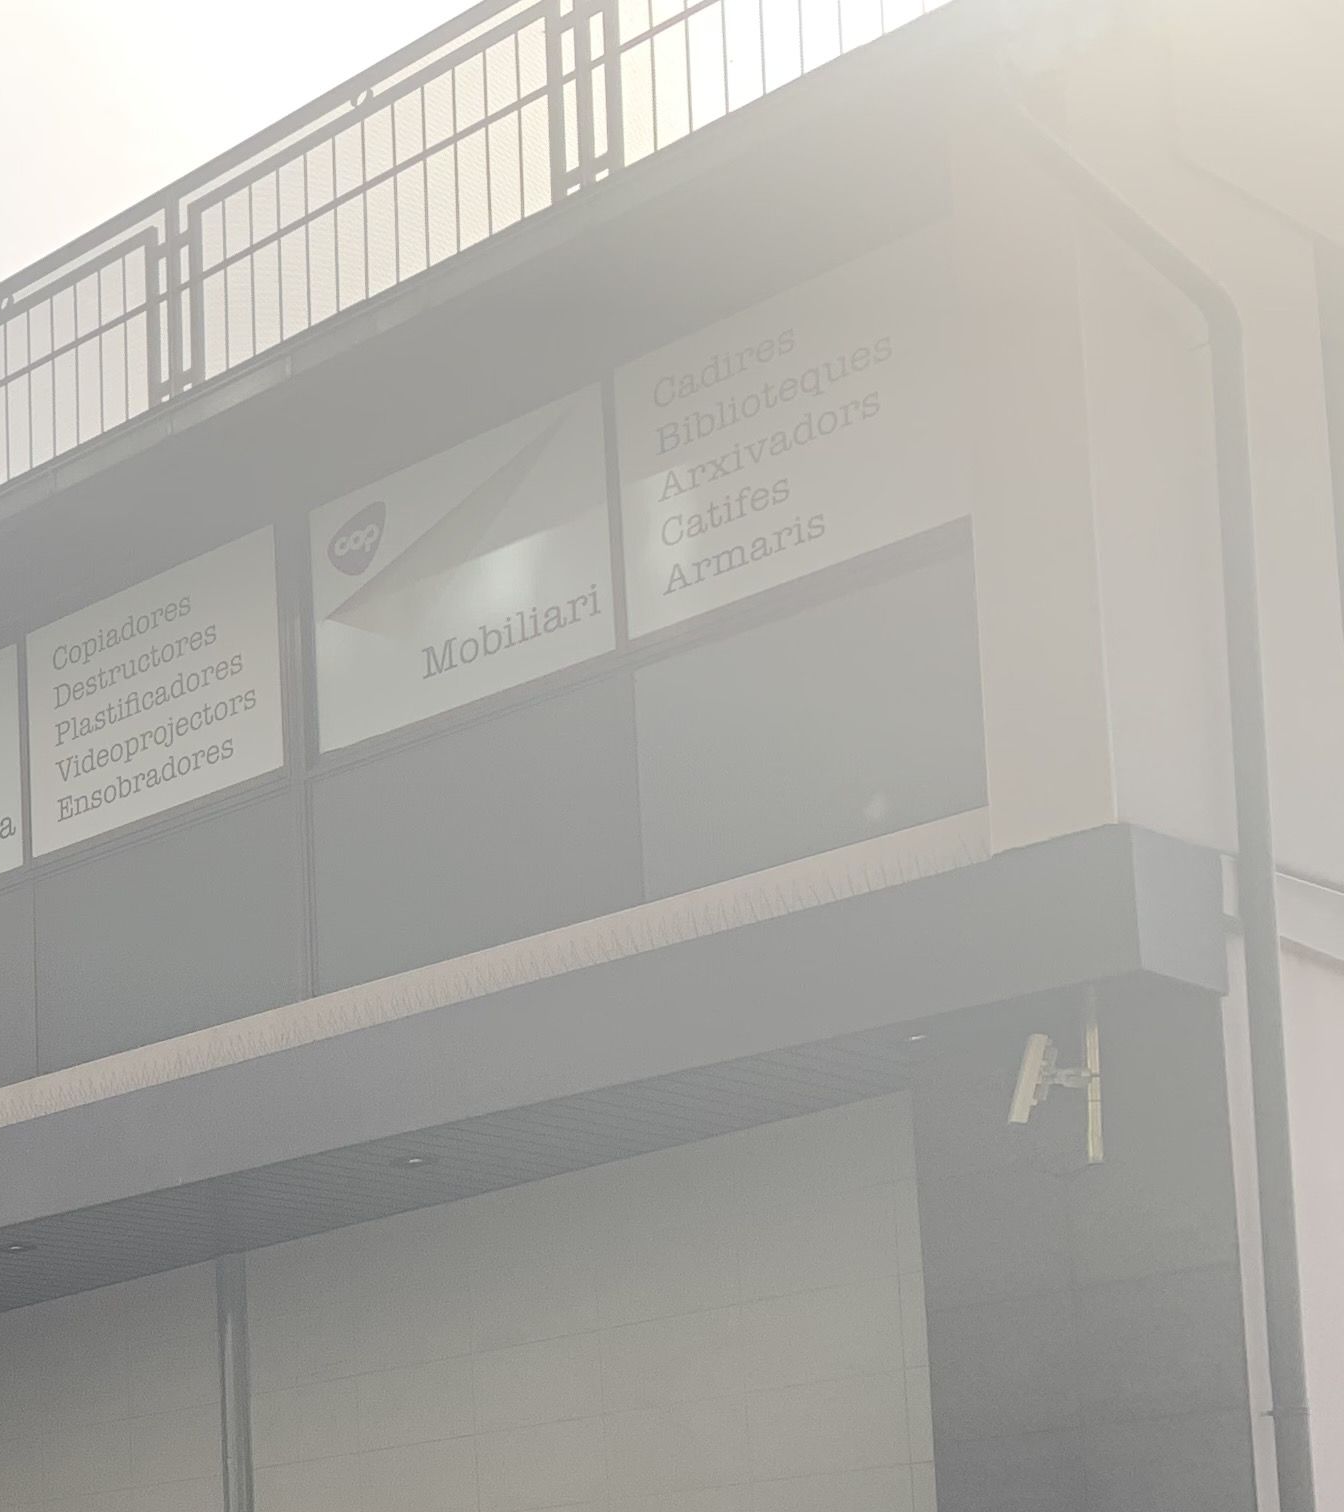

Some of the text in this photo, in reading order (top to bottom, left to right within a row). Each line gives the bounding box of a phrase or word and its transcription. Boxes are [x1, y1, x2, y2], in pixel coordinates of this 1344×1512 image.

[653, 326, 797, 408] Cadires
[654, 334, 894, 456] Biblioteques
[657, 388, 882, 503] Arxivadors
[334, 521, 382, 554] cop
[660, 475, 791, 548] Catifes
[662, 509, 827, 595] Armaris
[52, 594, 193, 671] Copiadores
[53, 624, 218, 710] Destructores
[422, 583, 602, 680] Mobiliari
[54, 653, 244, 747] Plastificadores
[55, 687, 258, 783] Videoprojectors
[56, 737, 235, 822] Ensobradores
